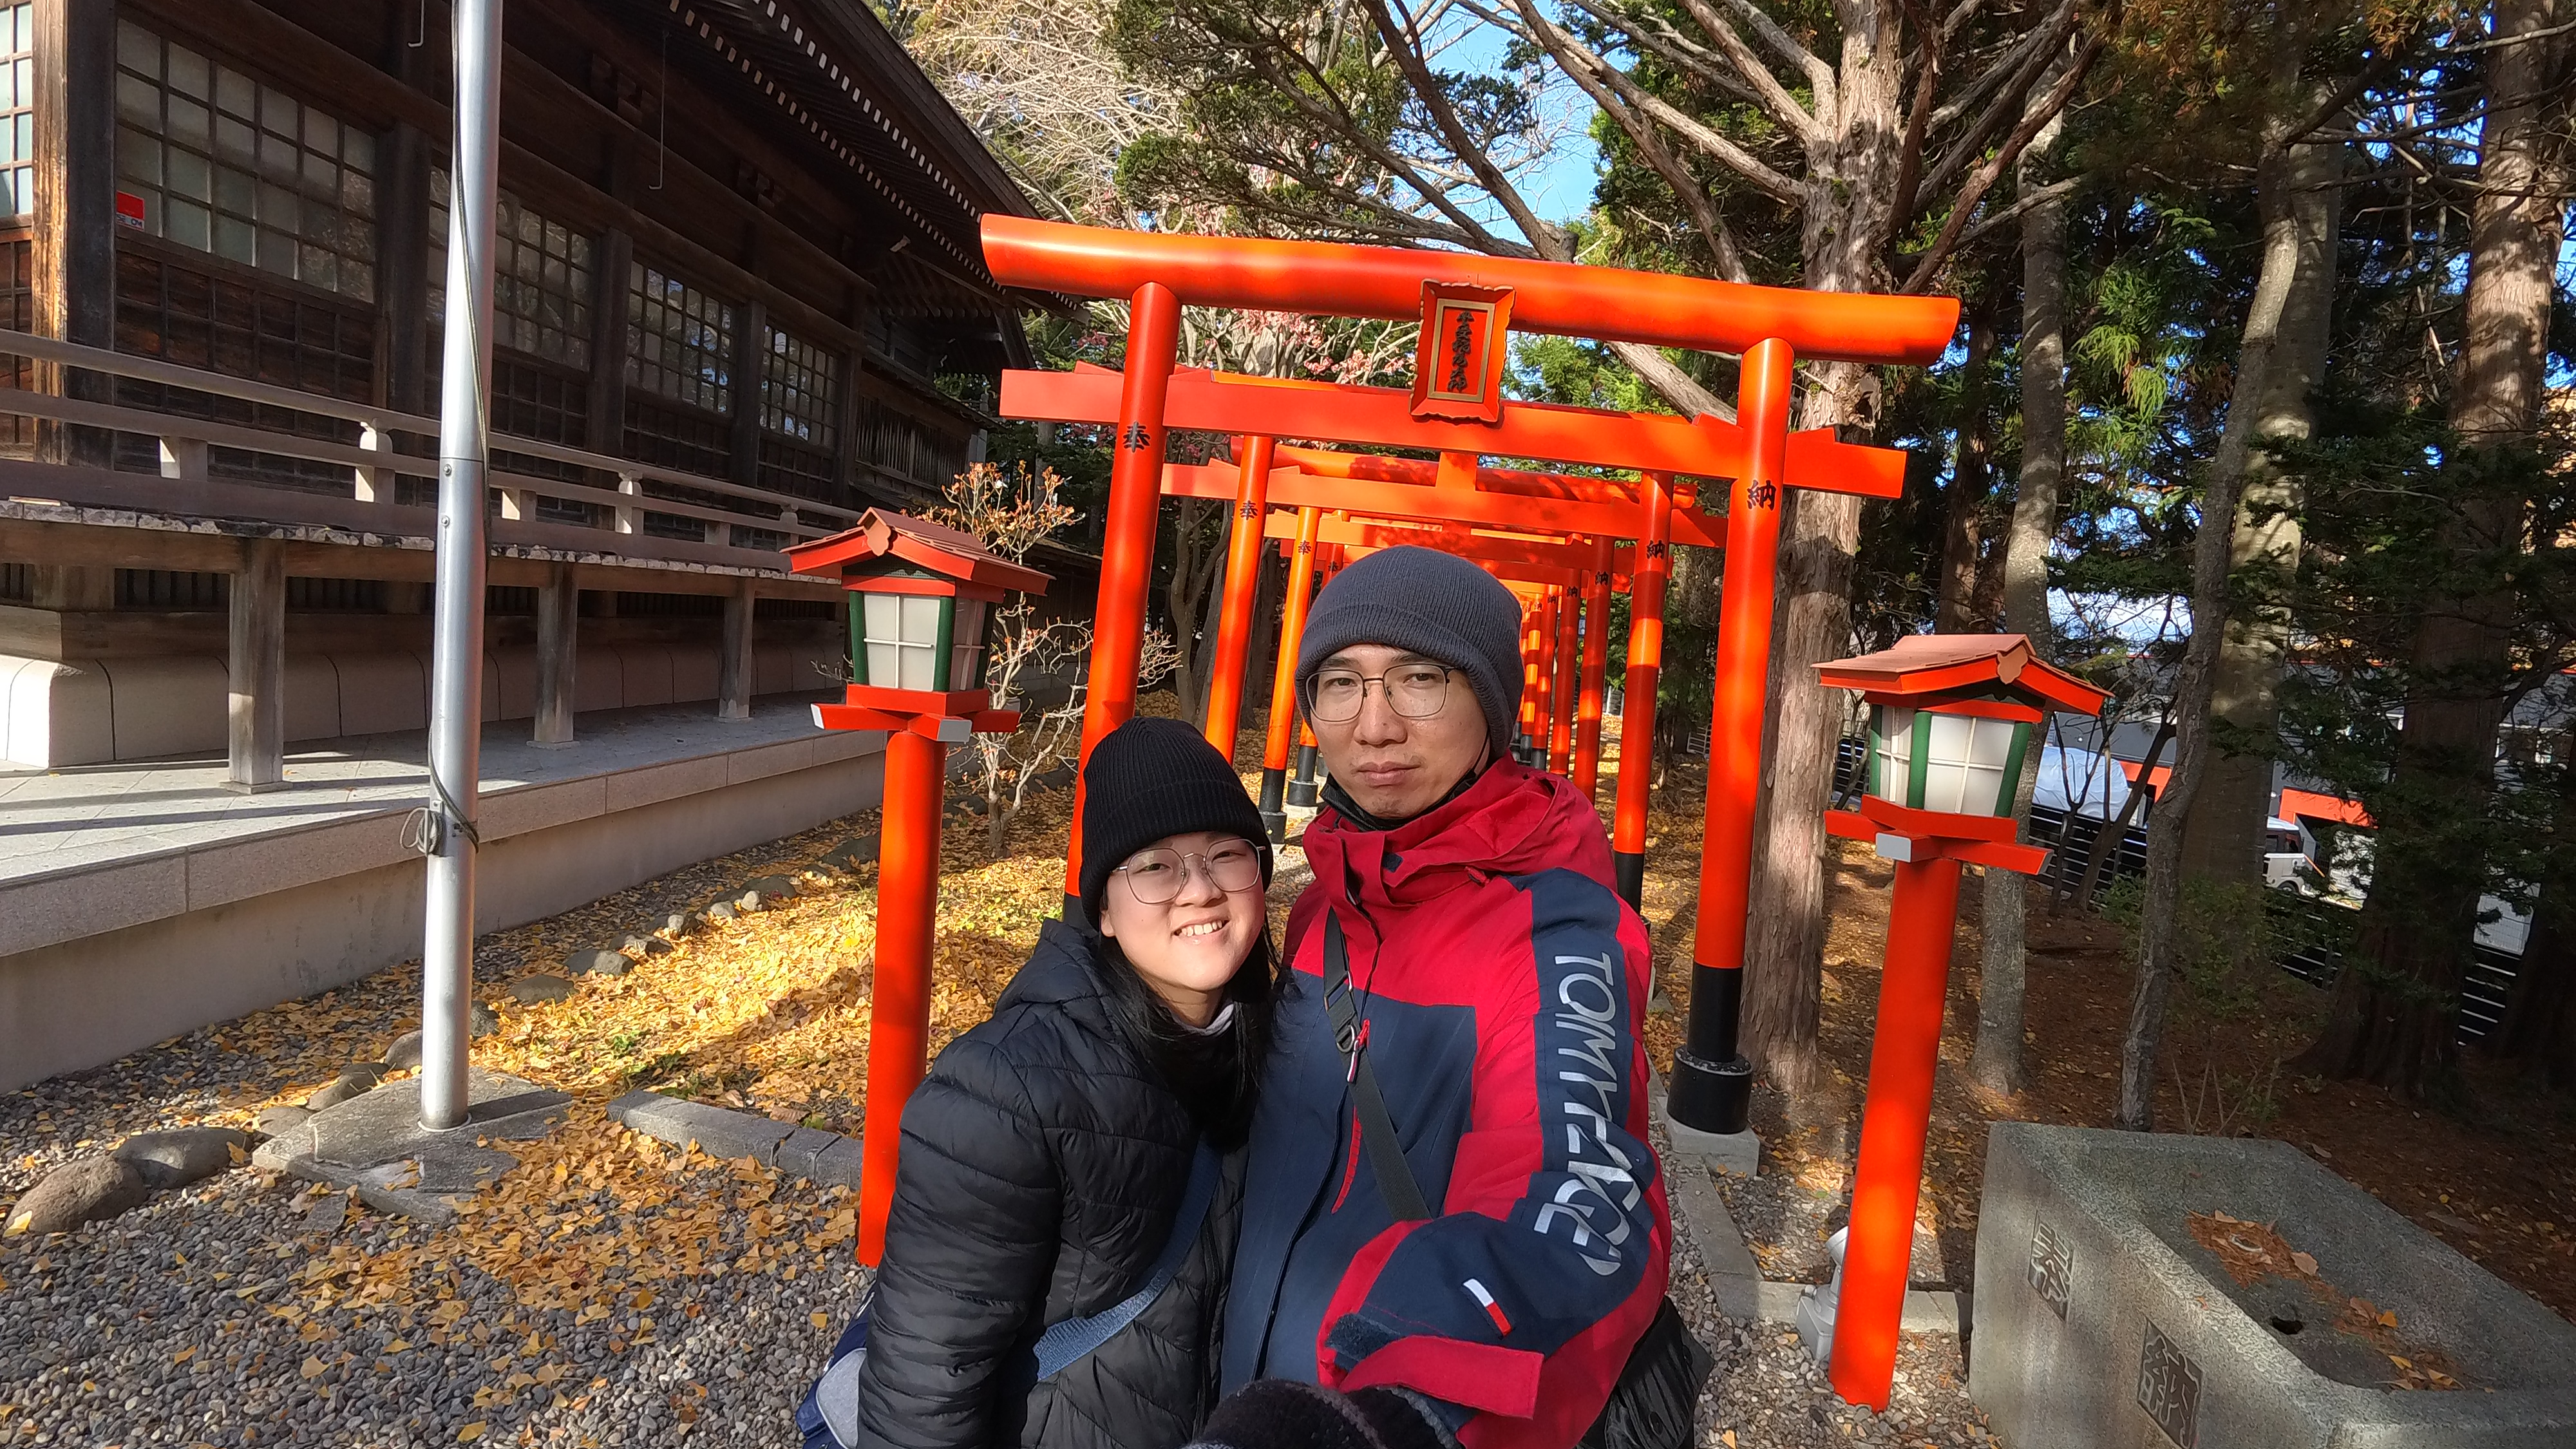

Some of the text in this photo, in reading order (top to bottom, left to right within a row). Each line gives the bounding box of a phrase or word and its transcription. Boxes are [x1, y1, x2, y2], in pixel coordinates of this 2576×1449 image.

[117, 214, 142, 227] SEOM
[1122, 421, 1151, 453] 奉
[1747, 479, 1776, 511] 納
[1240, 500, 1258, 520] 奉
[1298, 540, 1311, 555] 奉
[1646, 540, 1665, 559] 納
[1595, 571, 1609, 586] 納
